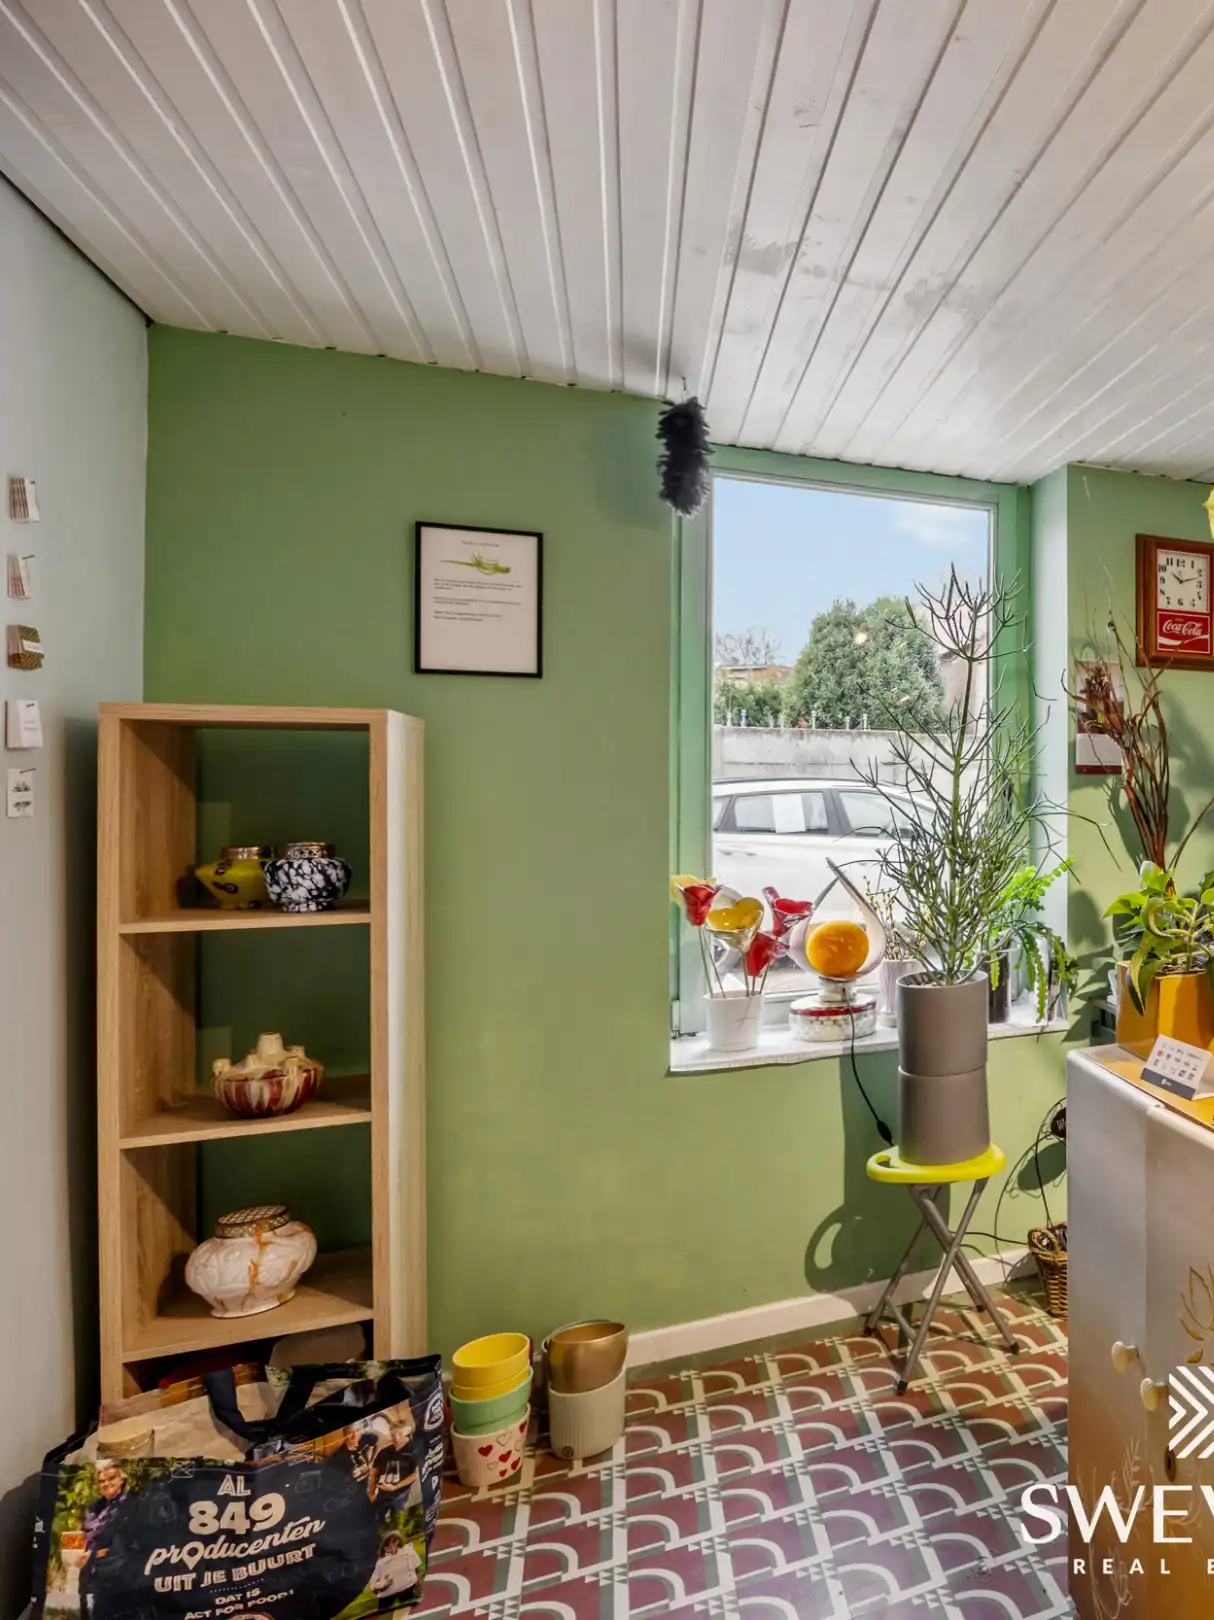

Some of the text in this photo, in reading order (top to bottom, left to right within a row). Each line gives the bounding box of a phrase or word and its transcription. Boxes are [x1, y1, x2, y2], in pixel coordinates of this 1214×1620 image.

[1158, 564, 1167, 573] 10
[1166, 557, 1173, 566] 11
[1176, 558, 1186, 568] 12
[1160, 576, 1166, 584] 9
[217, 1474, 252, 1497] AL
[188, 1492, 286, 1535] 849
[154, 1543, 317, 1593] UIT JE BUURT
[215, 1588, 261, 1605] DAT IS
[183, 1610, 212, 1620] ACT
[215, 1603, 244, 1616] FOR
